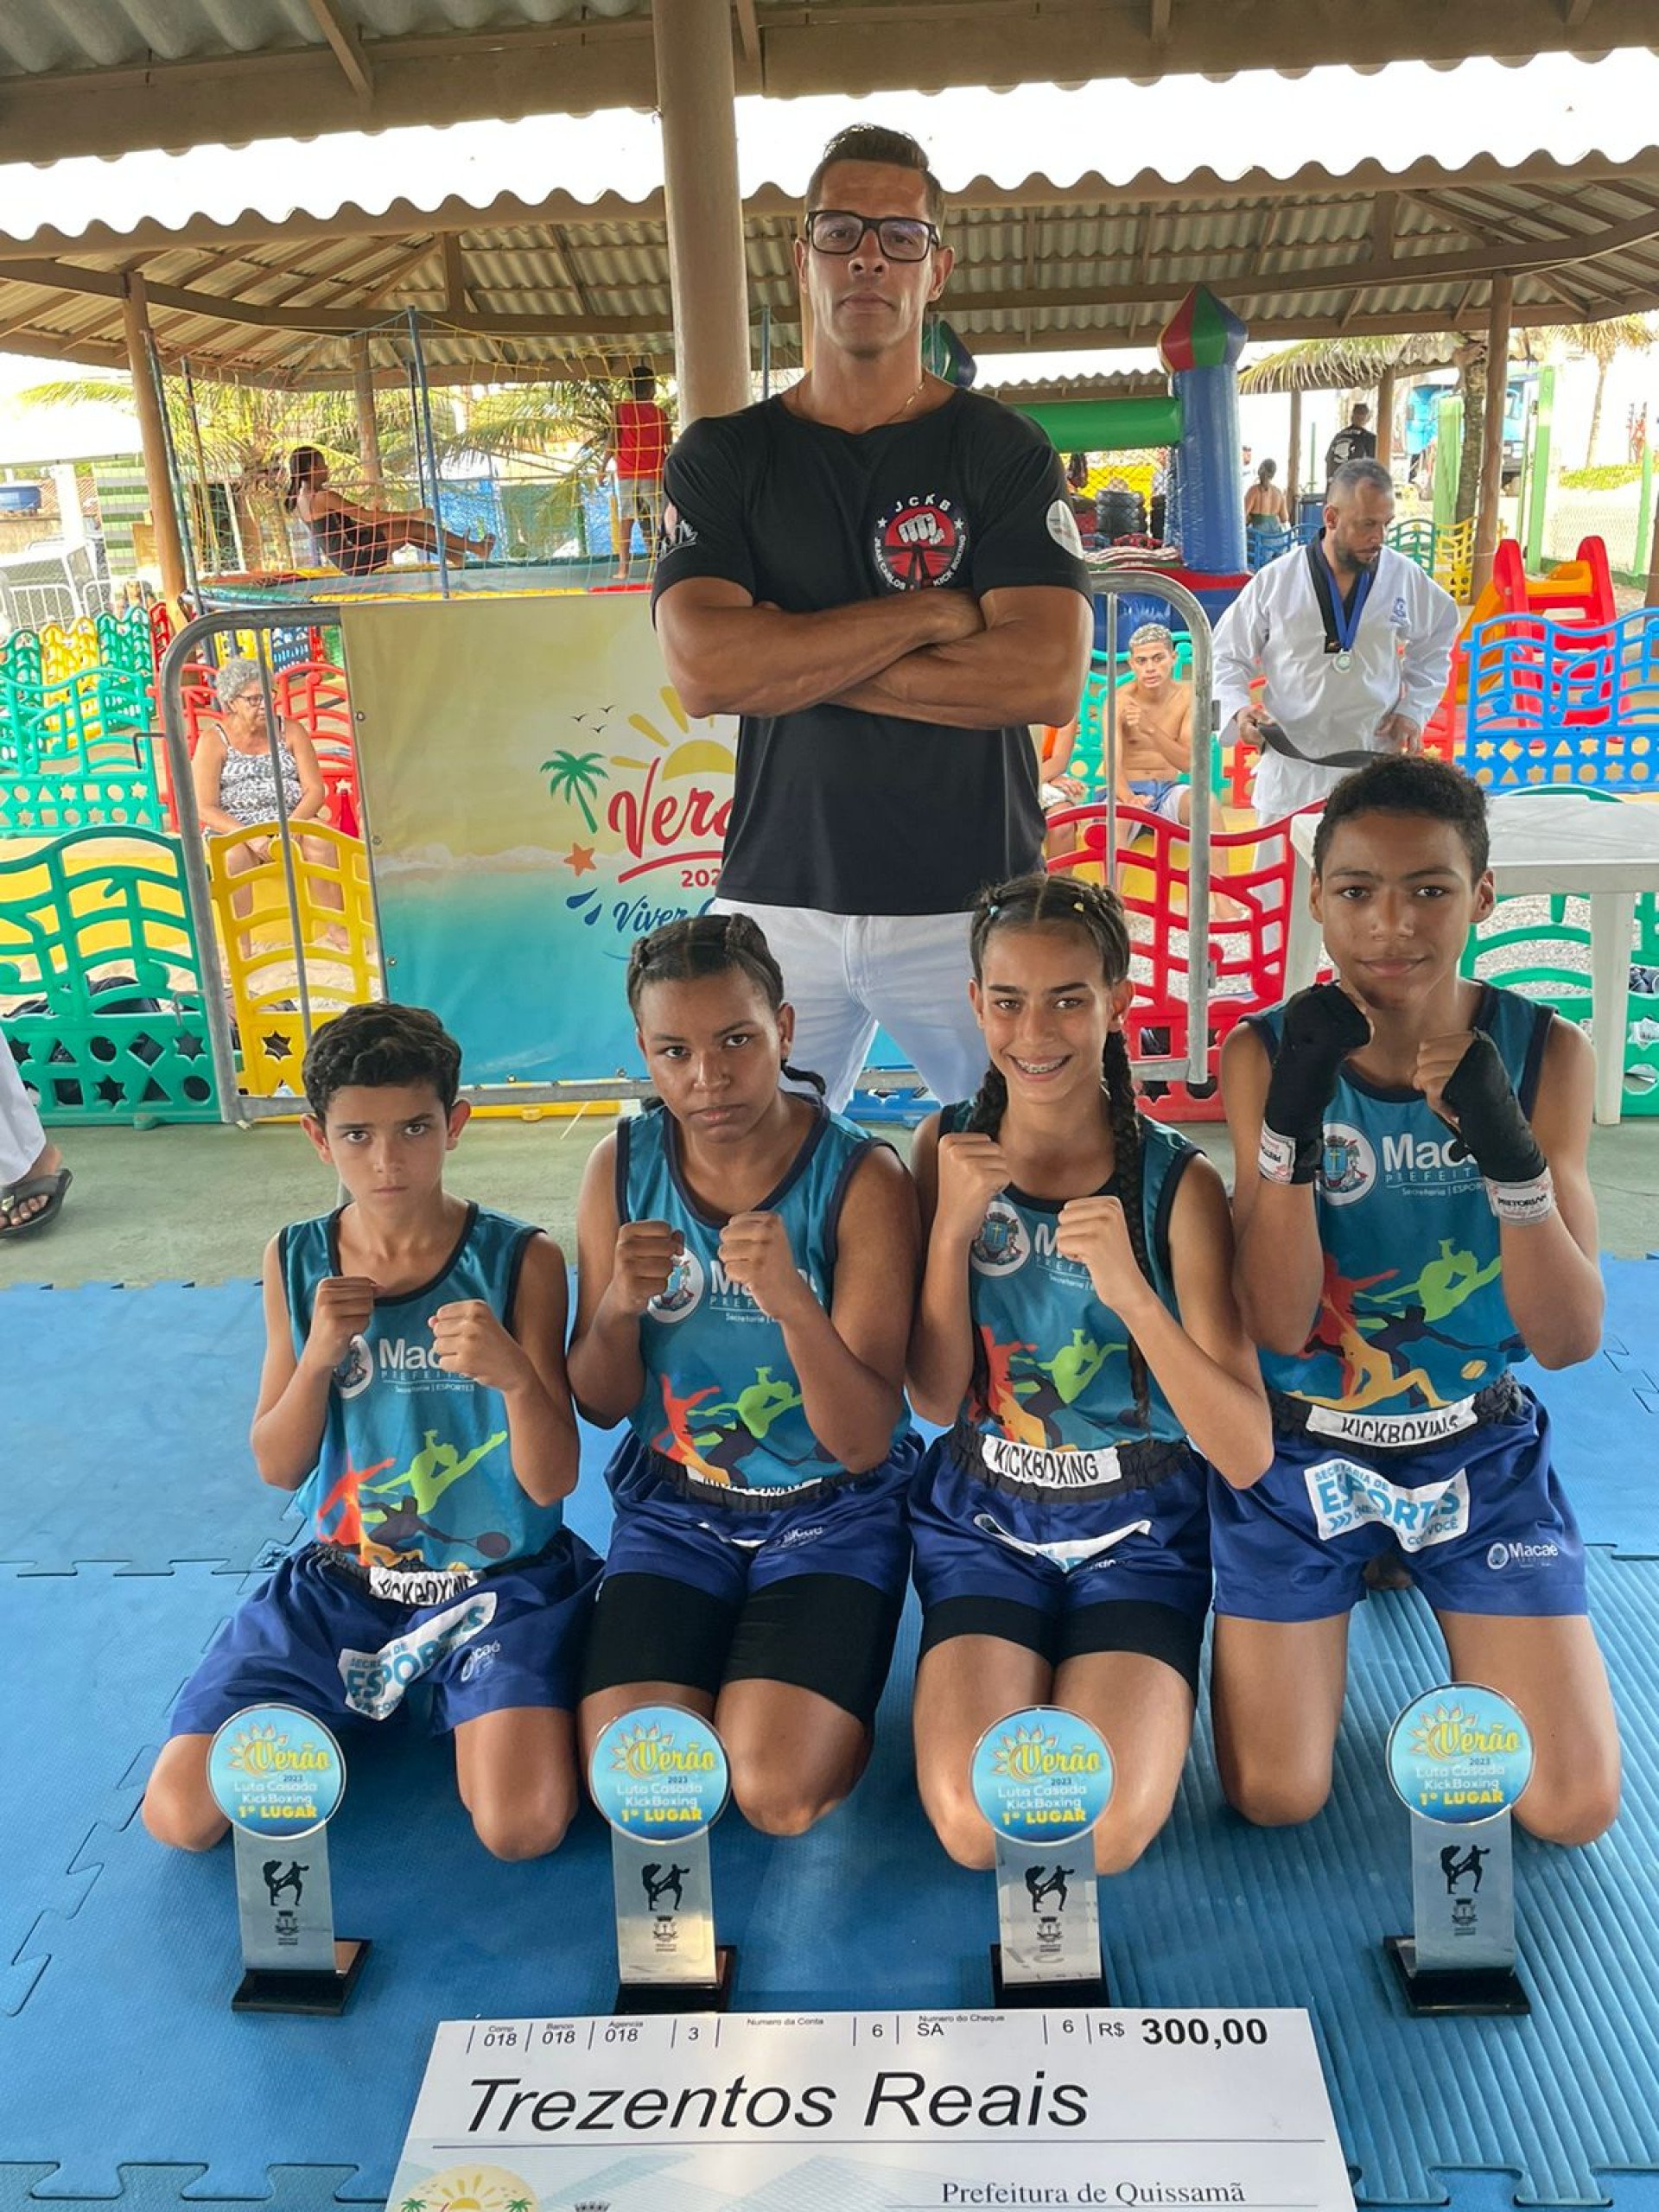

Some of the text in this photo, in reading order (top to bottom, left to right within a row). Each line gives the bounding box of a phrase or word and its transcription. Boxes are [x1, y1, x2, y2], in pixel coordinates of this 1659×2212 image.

[893, 493, 950, 513] JCKB
[607, 757, 734, 859] Ver
[681, 868, 722, 887] 202
[1382, 1133, 1478, 1173] Mac
[1384, 1167, 1472, 1183] PREFEIT
[378, 1338, 443, 1370] Mac
[995, 1440, 1100, 1485] KICKBOXING
[1438, 1723, 1519, 1752] Verão
[255, 1741, 330, 1770] Verão
[636, 1741, 715, 1770] Verão
[1020, 1744, 1100, 1773] Verão
[1417, 1767, 1448, 1777] Luta
[235, 1783, 264, 1791] Luta
[618, 1784, 648, 1795] Luta
[1425, 1779, 1499, 1790] KickBoxing
[998, 1788, 1031, 1797] Luta
[1444, 1789, 1503, 1805] LUGAR
[243, 1794, 312, 1806] KickBoxing
[626, 1796, 697, 1808] KickBoxing
[1007, 1798, 1080, 1812] KickBoxing
[261, 1806, 316, 1818] LUGAR
[645, 1808, 702, 1821] LUGAR
[1026, 1808, 1085, 1823] LUGAR
[969, 2014, 1004, 2023] Cheque
[1062, 2019, 1074, 2032] 6
[605, 2028, 639, 2042] 018
[688, 2027, 699, 2040] 3
[872, 2024, 883, 2037] 6
[917, 2023, 944, 2037] SA
[1098, 2018, 1268, 2050] R$ 300,00
[484, 2033, 517, 2046] 018
[543, 2031, 575, 2044] 018
[468, 2070, 1089, 2132] Trezentos Reais
[942, 2181, 1246, 2206] Prefeitura de Quissamã
